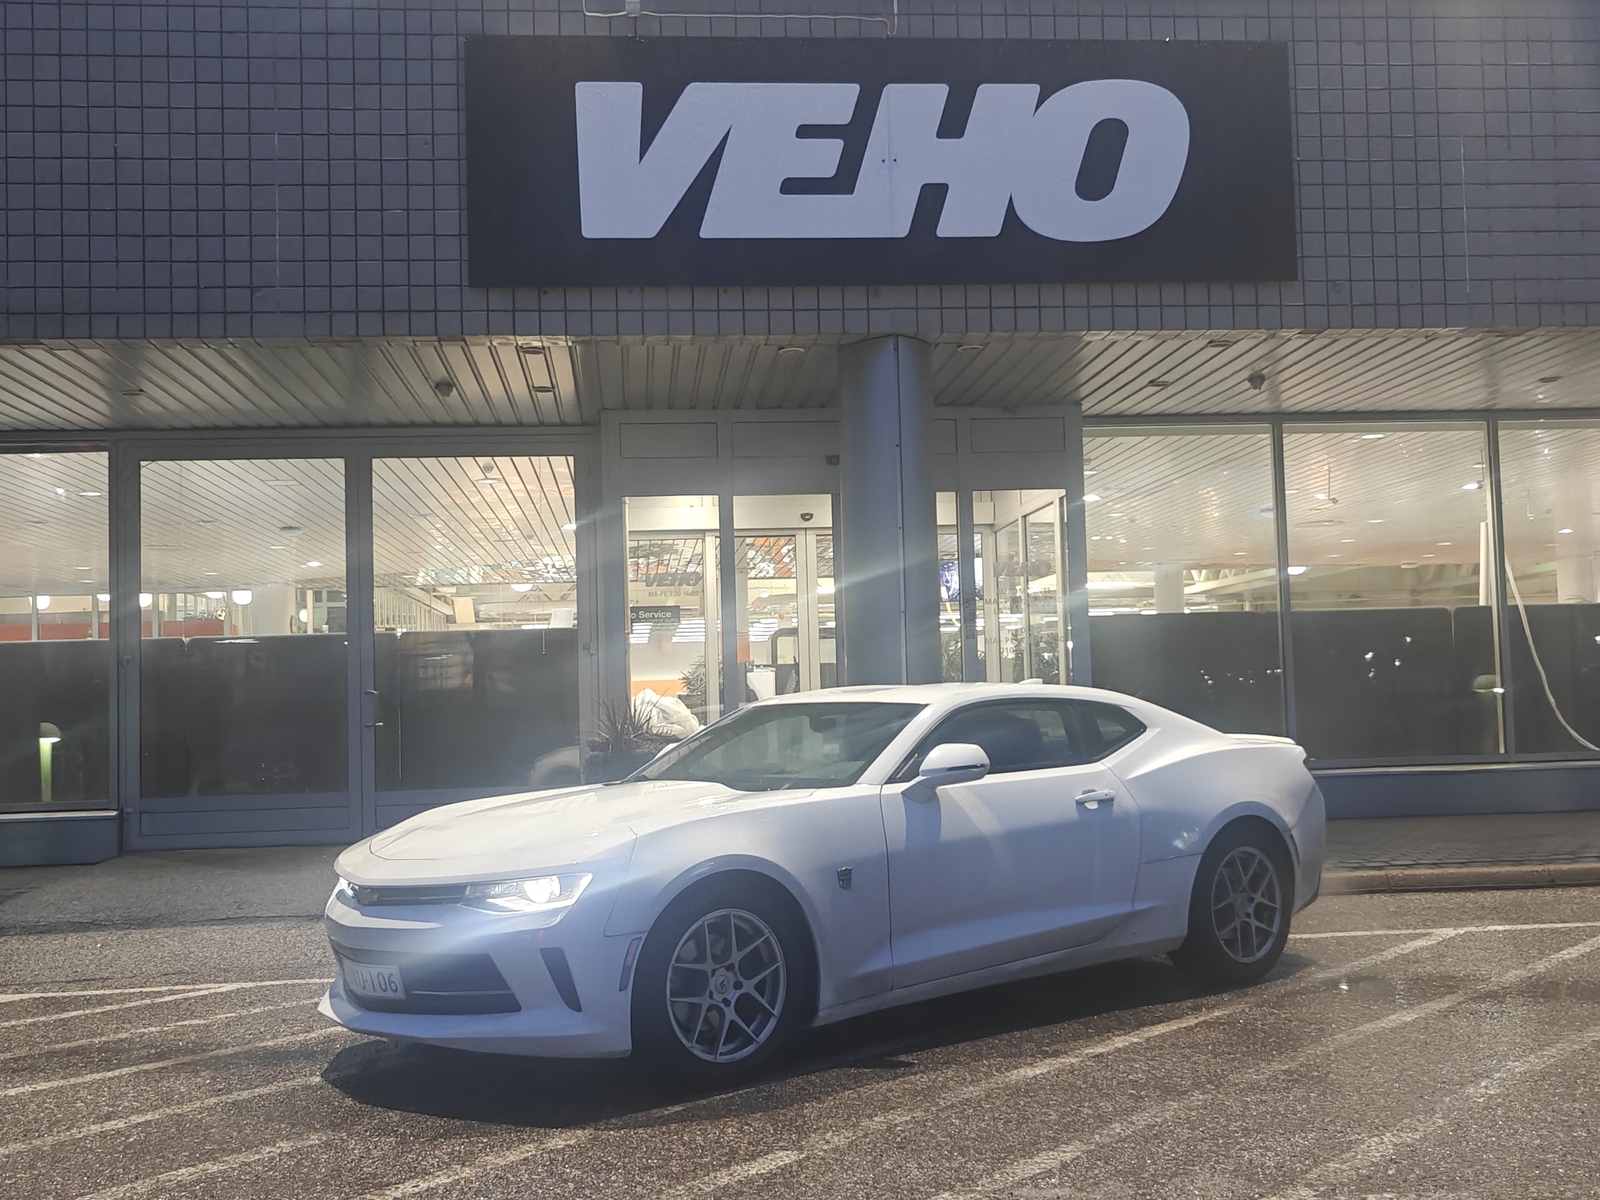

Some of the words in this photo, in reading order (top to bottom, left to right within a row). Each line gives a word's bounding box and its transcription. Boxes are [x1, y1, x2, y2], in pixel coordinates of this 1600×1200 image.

[574, 78, 1190, 243] VEHO
[645, 572, 701, 587] VEHO
[638, 610, 672, 619] Service
